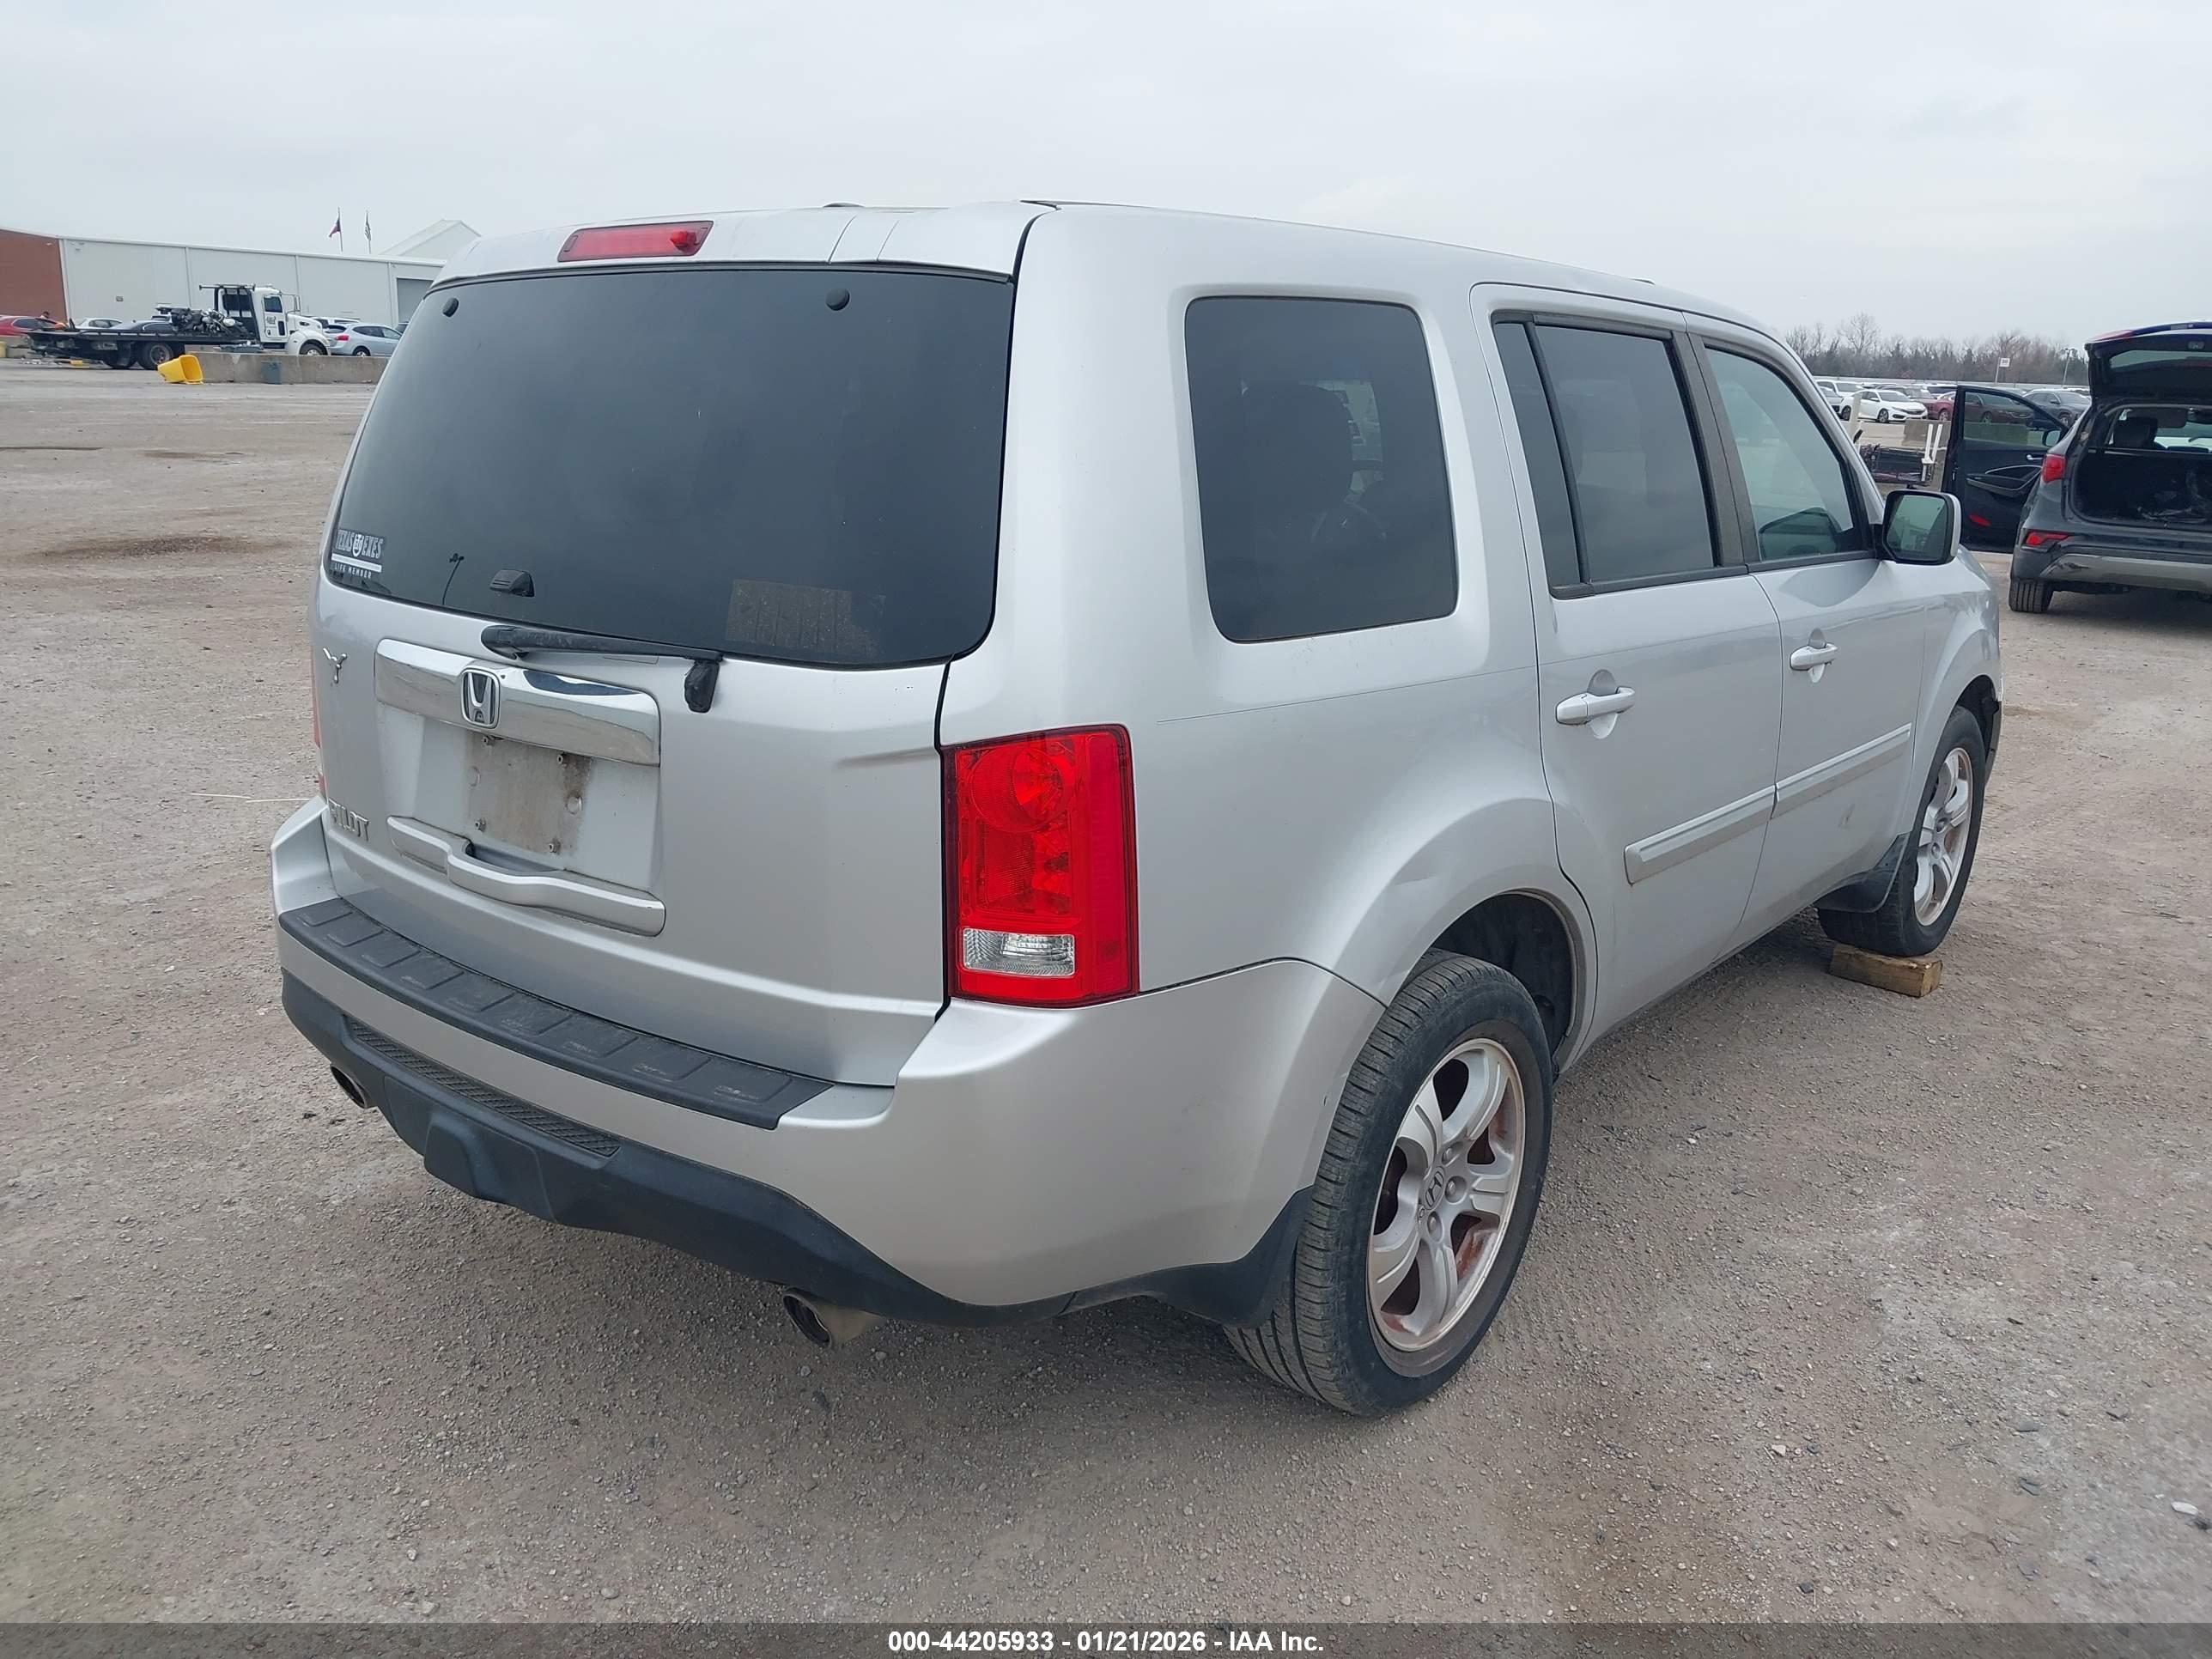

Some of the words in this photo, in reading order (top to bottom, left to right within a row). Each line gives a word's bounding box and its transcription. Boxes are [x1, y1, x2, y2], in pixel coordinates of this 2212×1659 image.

[362, 535, 384, 559] EXES
[334, 562, 346, 573] LIFE
[348, 566, 372, 580] MEMBER
